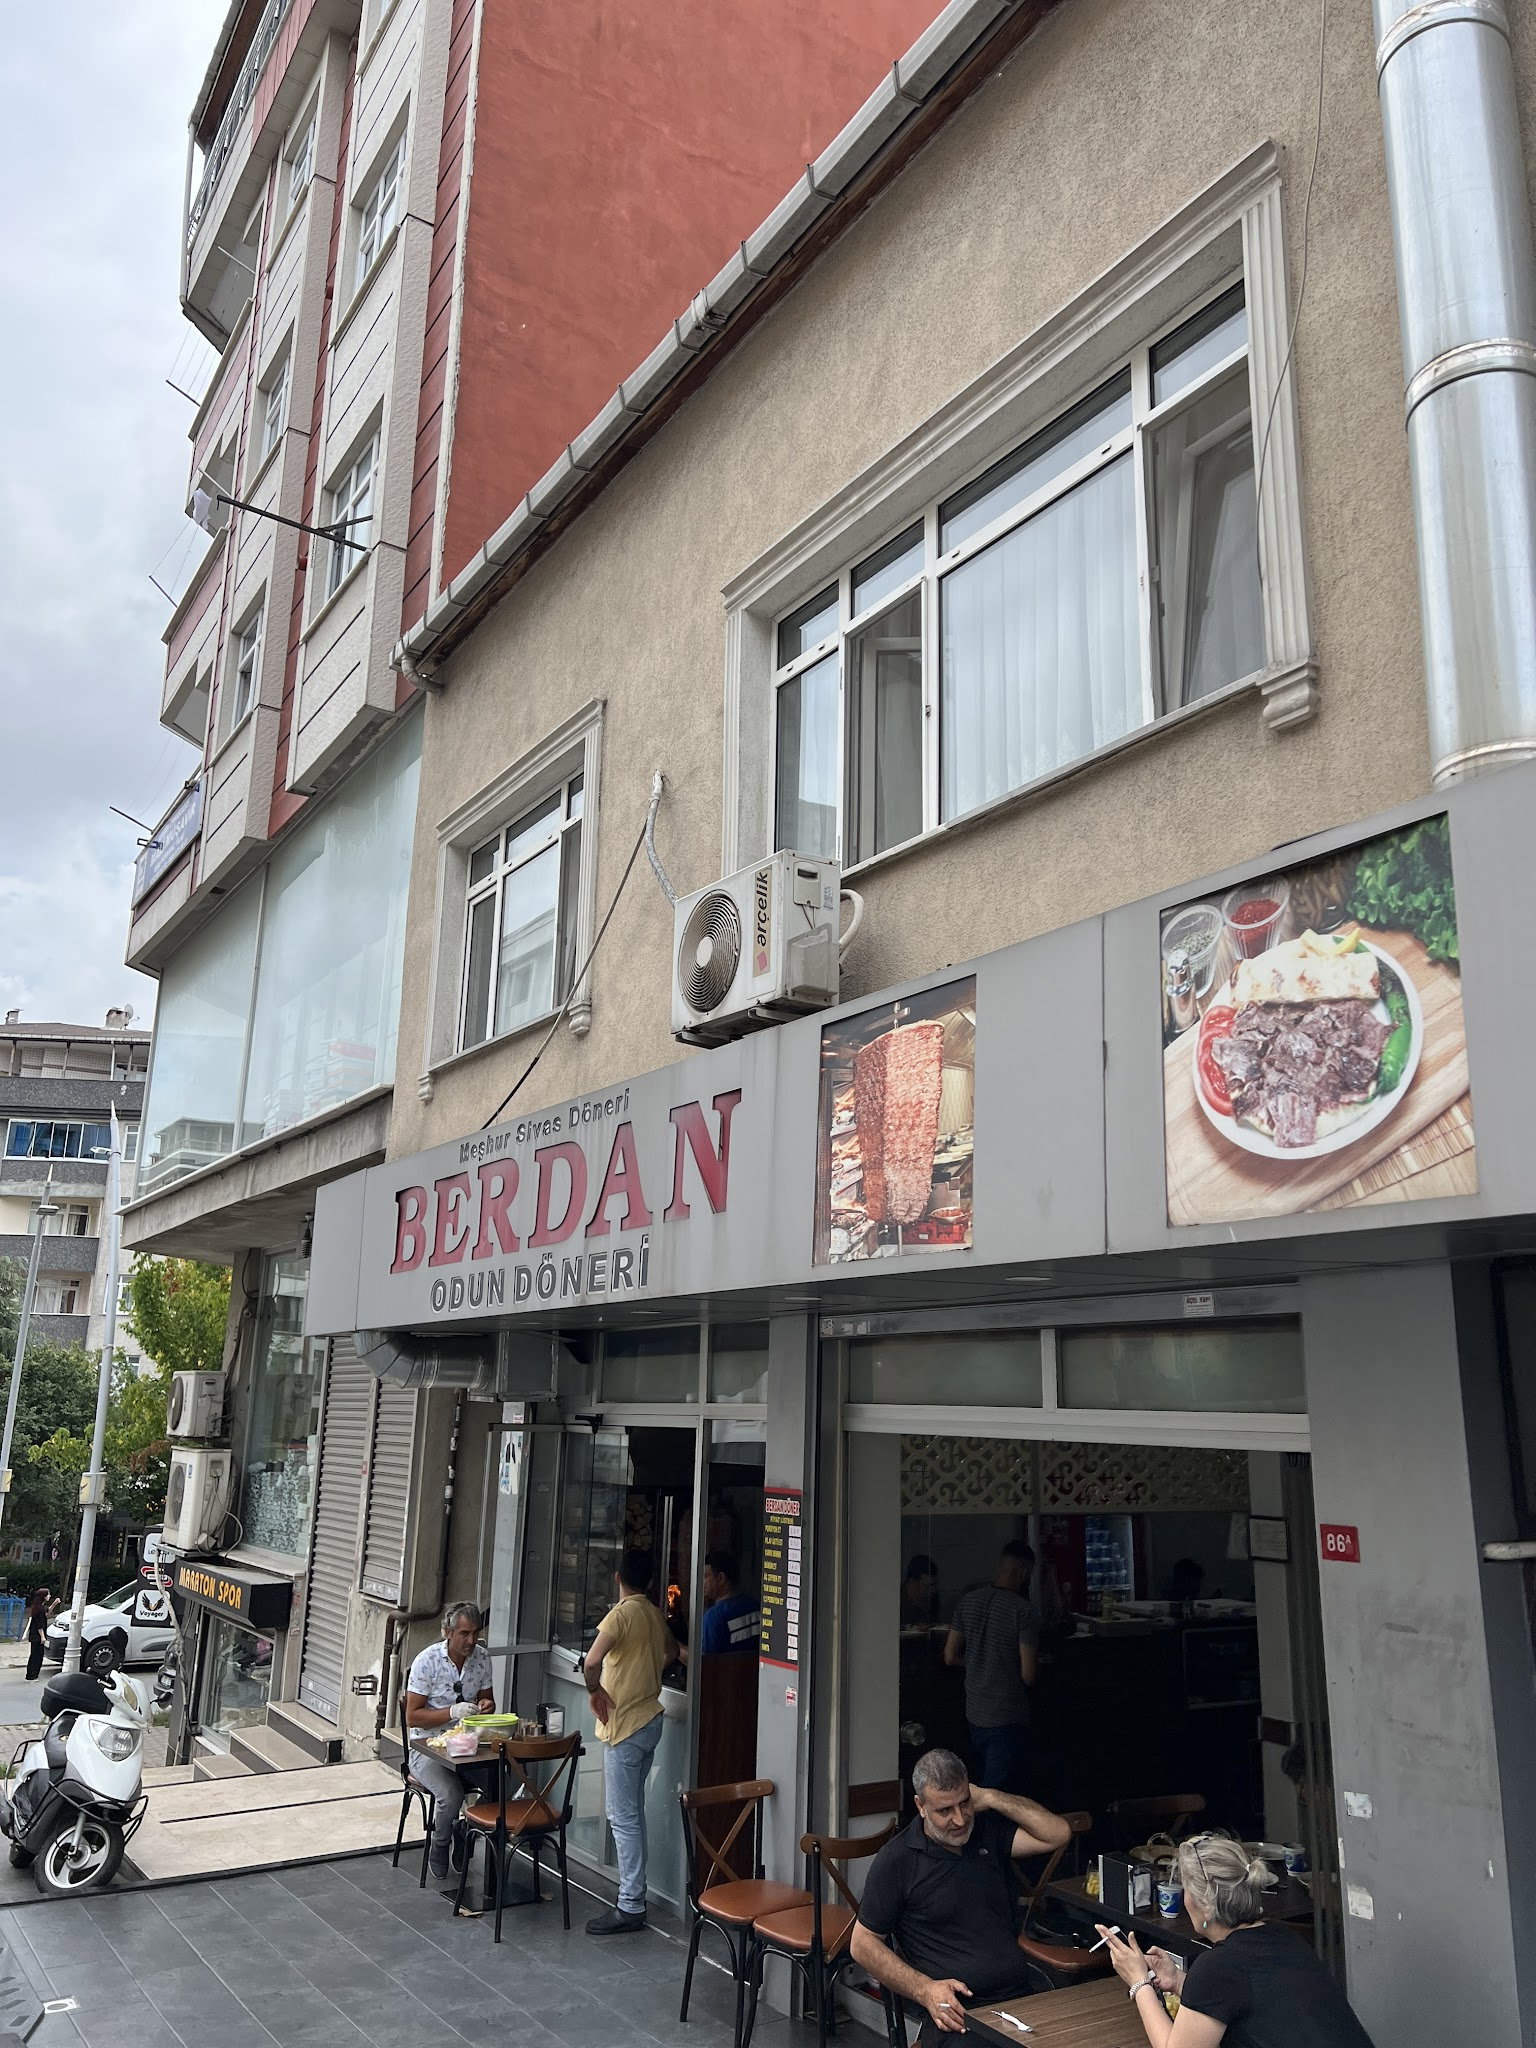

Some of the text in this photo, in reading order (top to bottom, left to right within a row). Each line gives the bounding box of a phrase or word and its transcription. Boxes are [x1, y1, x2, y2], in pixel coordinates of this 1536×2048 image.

[756, 871, 769, 947] arçelik
[459, 1087, 631, 1164] Meşhur Sivas Döneri
[390, 1087, 742, 1274] BERDAN
[430, 1234, 651, 1313] ODUN DÖNERİ
[1326, 1533, 1352, 1552] 86A
[139, 1610, 164, 1618] Voyager
[179, 1567, 242, 1609] MARATON SPOR
